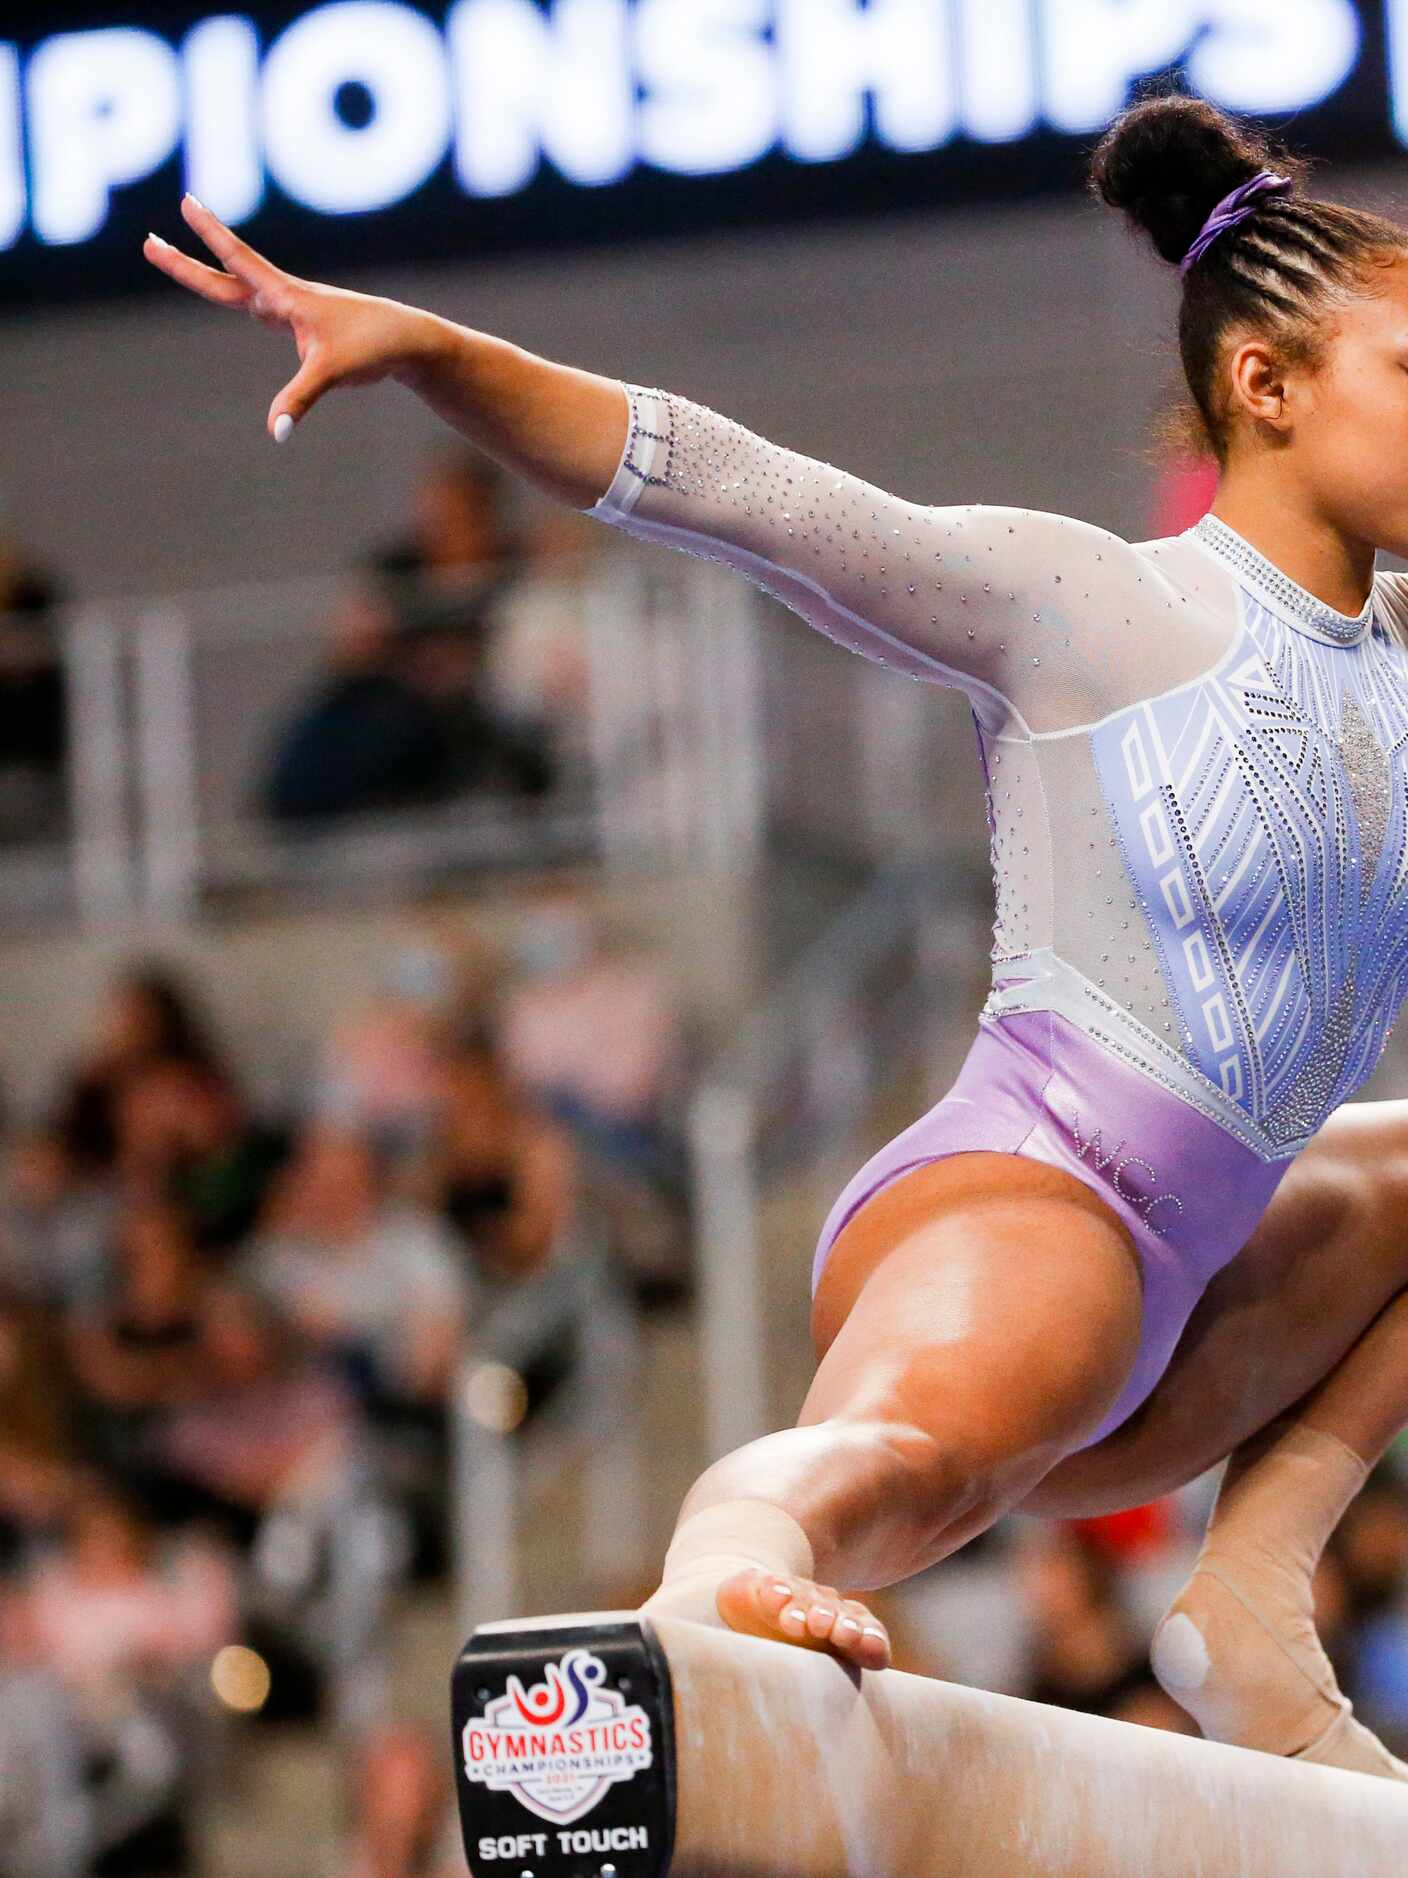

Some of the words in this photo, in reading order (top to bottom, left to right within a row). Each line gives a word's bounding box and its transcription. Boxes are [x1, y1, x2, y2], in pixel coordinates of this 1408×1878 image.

[0, 0, 1358, 250] PIONSHIPS
[469, 1717, 645, 1761] GYMNASTICS
[483, 1754, 635, 1776] CHAMPIONSHIPS
[478, 1833, 548, 1860] SOFT
[557, 1826, 649, 1854] TOUCH
